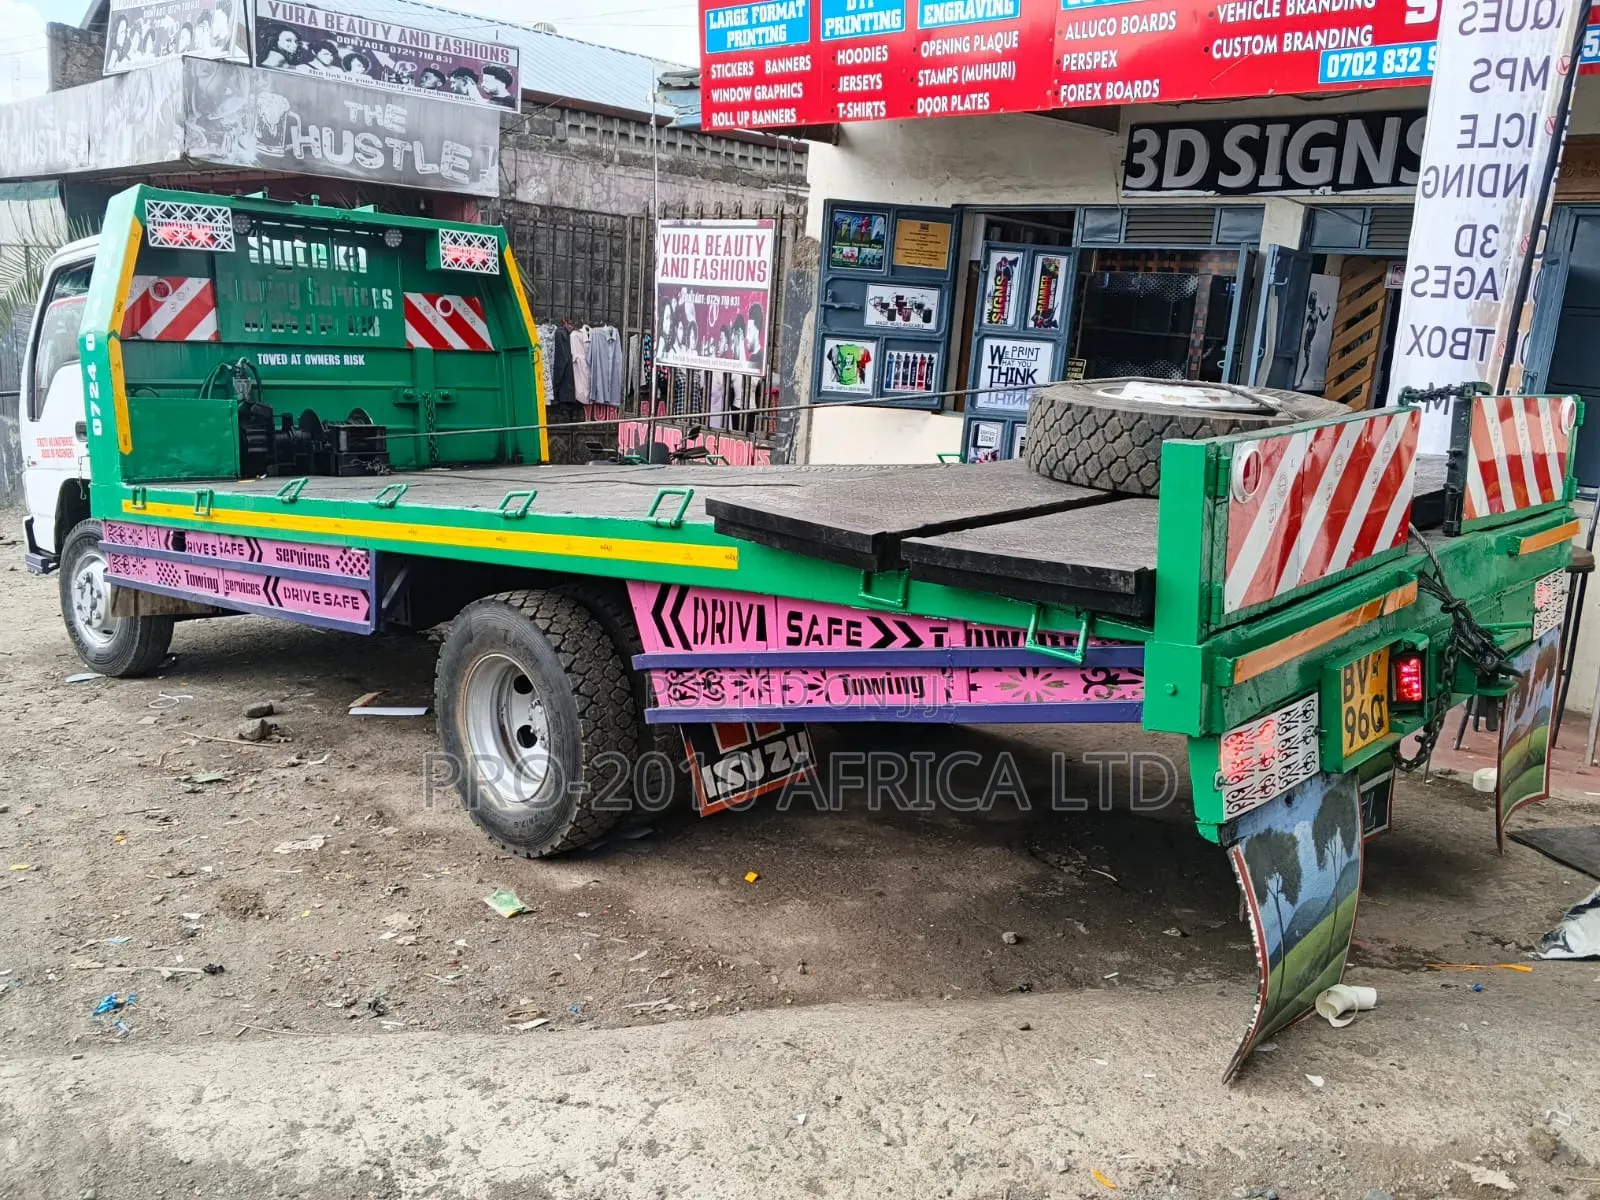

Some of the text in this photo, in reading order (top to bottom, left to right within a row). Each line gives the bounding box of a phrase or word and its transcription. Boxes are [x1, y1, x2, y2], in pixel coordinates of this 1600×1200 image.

[709, 2, 806, 29] LARGE FORMAT
[825, 8, 902, 36] PRINTING
[923, 0, 1014, 25] ENGRAVING
[1216, 1, 1282, 24] VEHICLE
[268, 2, 511, 64] YURA BEAUTY AND FASHIONS
[726, 25, 787, 48] PRINTING
[1065, 11, 1177, 41] ALLUCO BOARDS
[920, 30, 1020, 58] OPENING PLAQUE
[1212, 25, 1373, 60] CUSTOM BRANDING
[711, 55, 811, 79] STICKERS BANNERS
[837, 45, 889, 66] HOODIES
[1062, 50, 1118, 72] PERSPEX
[1327, 51, 1377, 78] 0702
[1382, 46, 1422, 74] 832
[838, 73, 883, 93] JERSEYS
[918, 61, 1017, 87] STAMPS (MUHURI)
[711, 82, 803, 103] WINDOW GRAPHICS
[1060, 79, 1160, 103] FOREX BOARDS
[837, 101, 887, 119] T-SHIRTS
[917, 93, 990, 115] DOOR PLATES
[344, 100, 408, 134] THE
[712, 108, 797, 127] ROLL UP BANNERS
[290, 125, 473, 185] HUSTLE
[1125, 116, 1426, 189] 3D SIGNS
[662, 233, 766, 258] YURA BEAUTY
[661, 257, 767, 283] AND FASHIONS
[992, 275, 1005, 323] SIGNS
[257, 353, 366, 366] TOWED AT OWNERS RISK
[1011, 345, 1041, 362] PRINT
[988, 365, 1038, 389] THINK
[185, 569, 219, 594] Towing
[284, 586, 360, 611] DRIVE SAFE
[786, 610, 862, 647] SAFE
[701, 731, 810, 799] ISUZU
